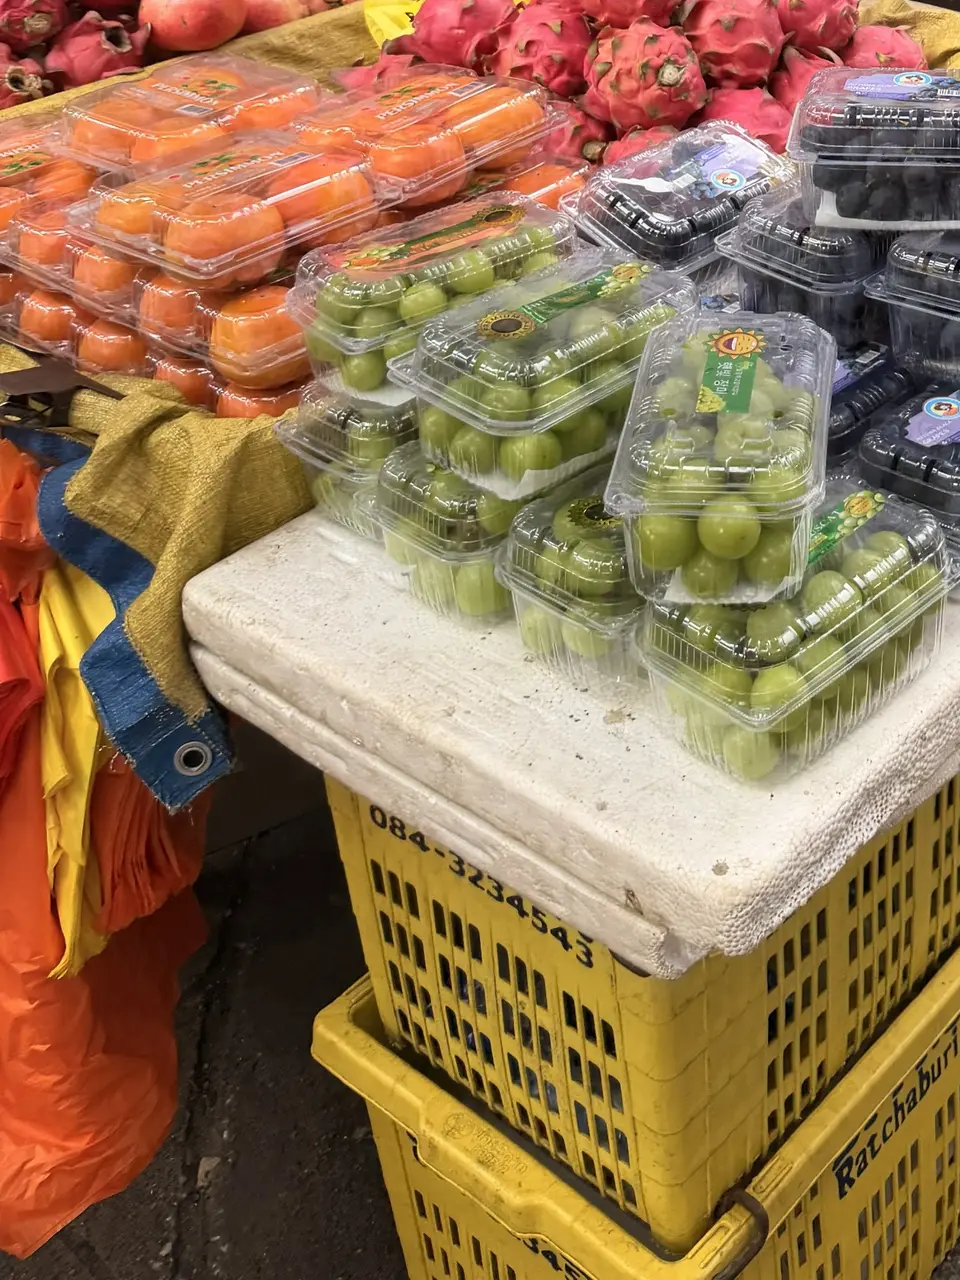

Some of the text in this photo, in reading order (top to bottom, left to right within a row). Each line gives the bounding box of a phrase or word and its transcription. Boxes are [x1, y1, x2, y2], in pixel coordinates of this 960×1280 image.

[375, 82, 459, 120] PERSIMMON
[183, 150, 286, 189] PERSIMMON
[368, 803, 594, 969] 084-3234543
